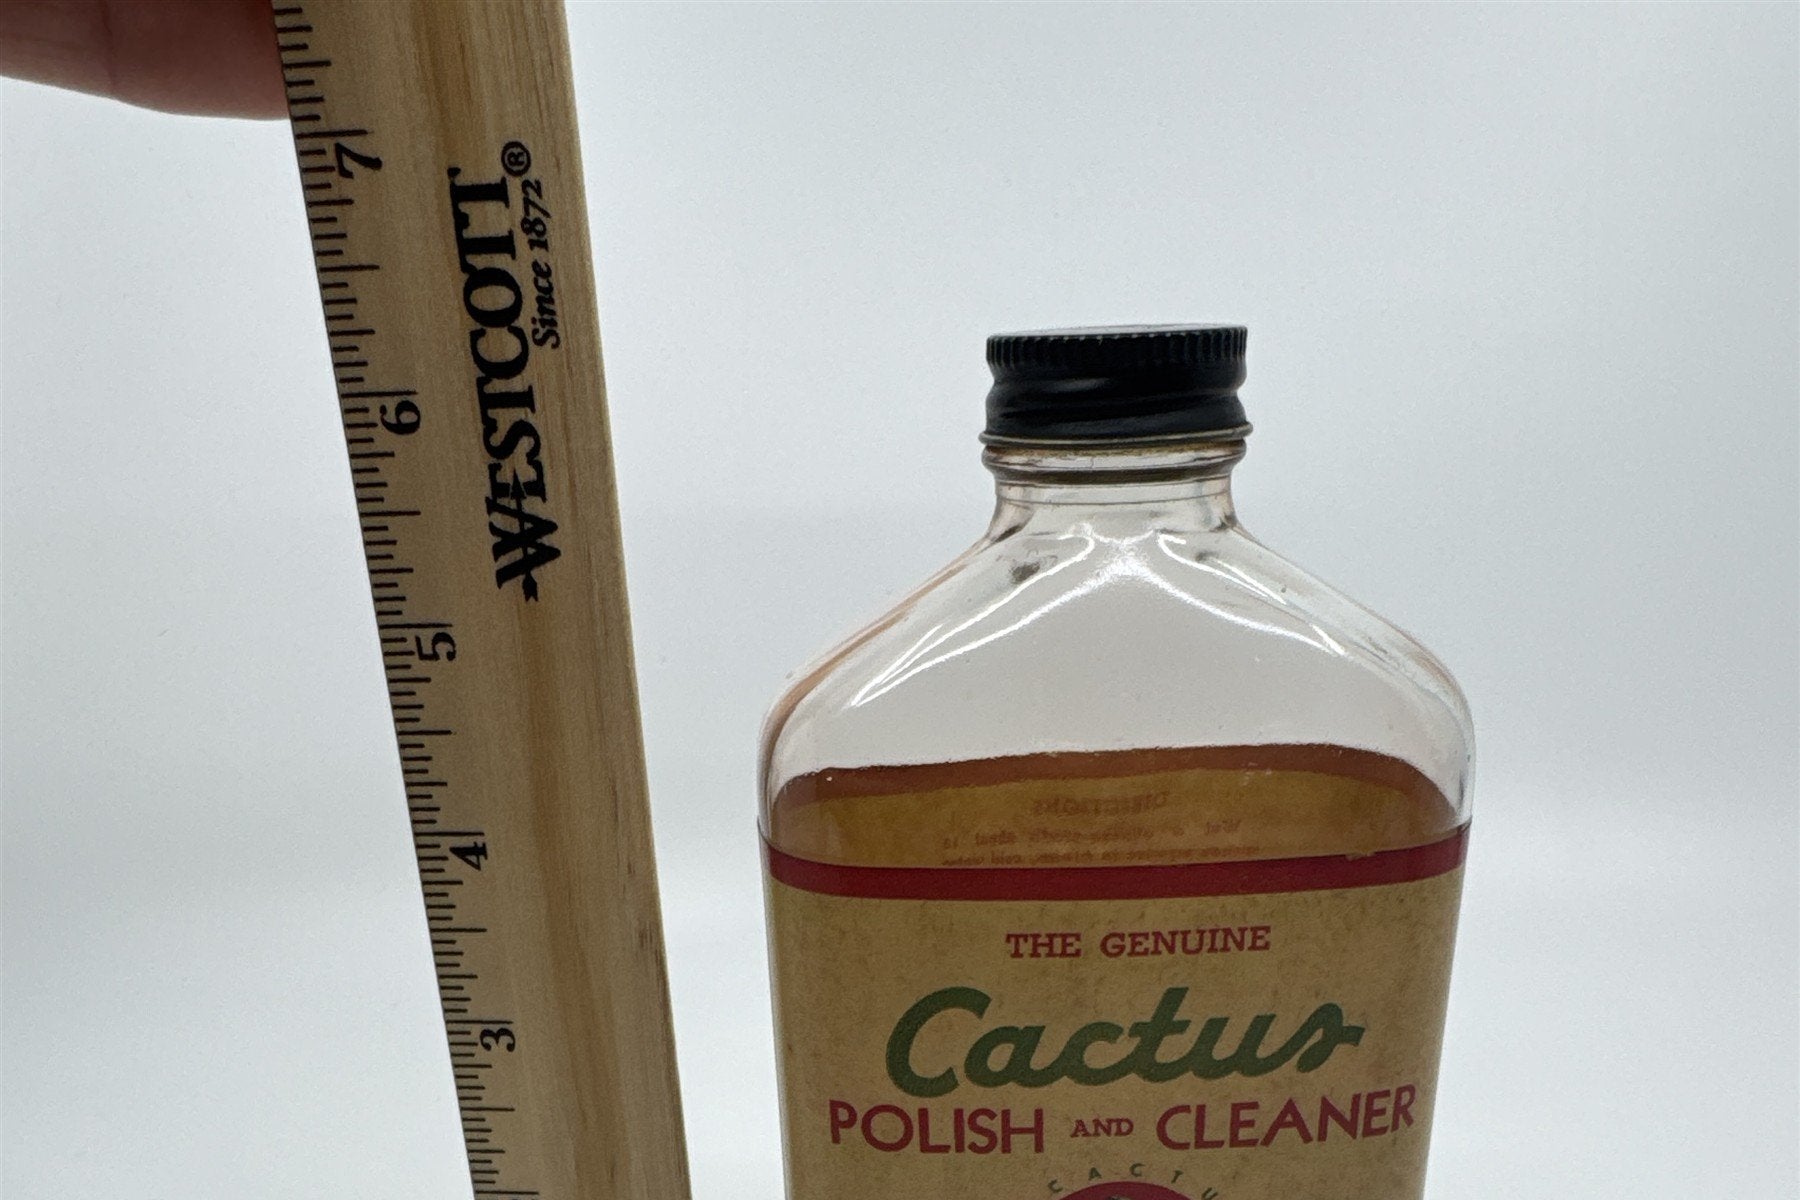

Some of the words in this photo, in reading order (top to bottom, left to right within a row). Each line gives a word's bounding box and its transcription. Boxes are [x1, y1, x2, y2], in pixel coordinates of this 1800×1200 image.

[333, 143, 382, 179] 7
[520, 179, 552, 252] 1872
[531, 258, 561, 350] Since
[379, 400, 421, 435] 6
[416, 632, 456, 662] 5
[449, 841, 488, 871] 4
[1006, 932, 1082, 958] THE
[1100, 926, 1272, 958] GENUINE
[479, 1027, 516, 1053] 3
[885, 986, 1366, 1098] Cactus
[829, 1099, 1044, 1154] POLISH
[1069, 1117, 1134, 1138] AND
[1156, 1083, 1416, 1151] CLEANER
